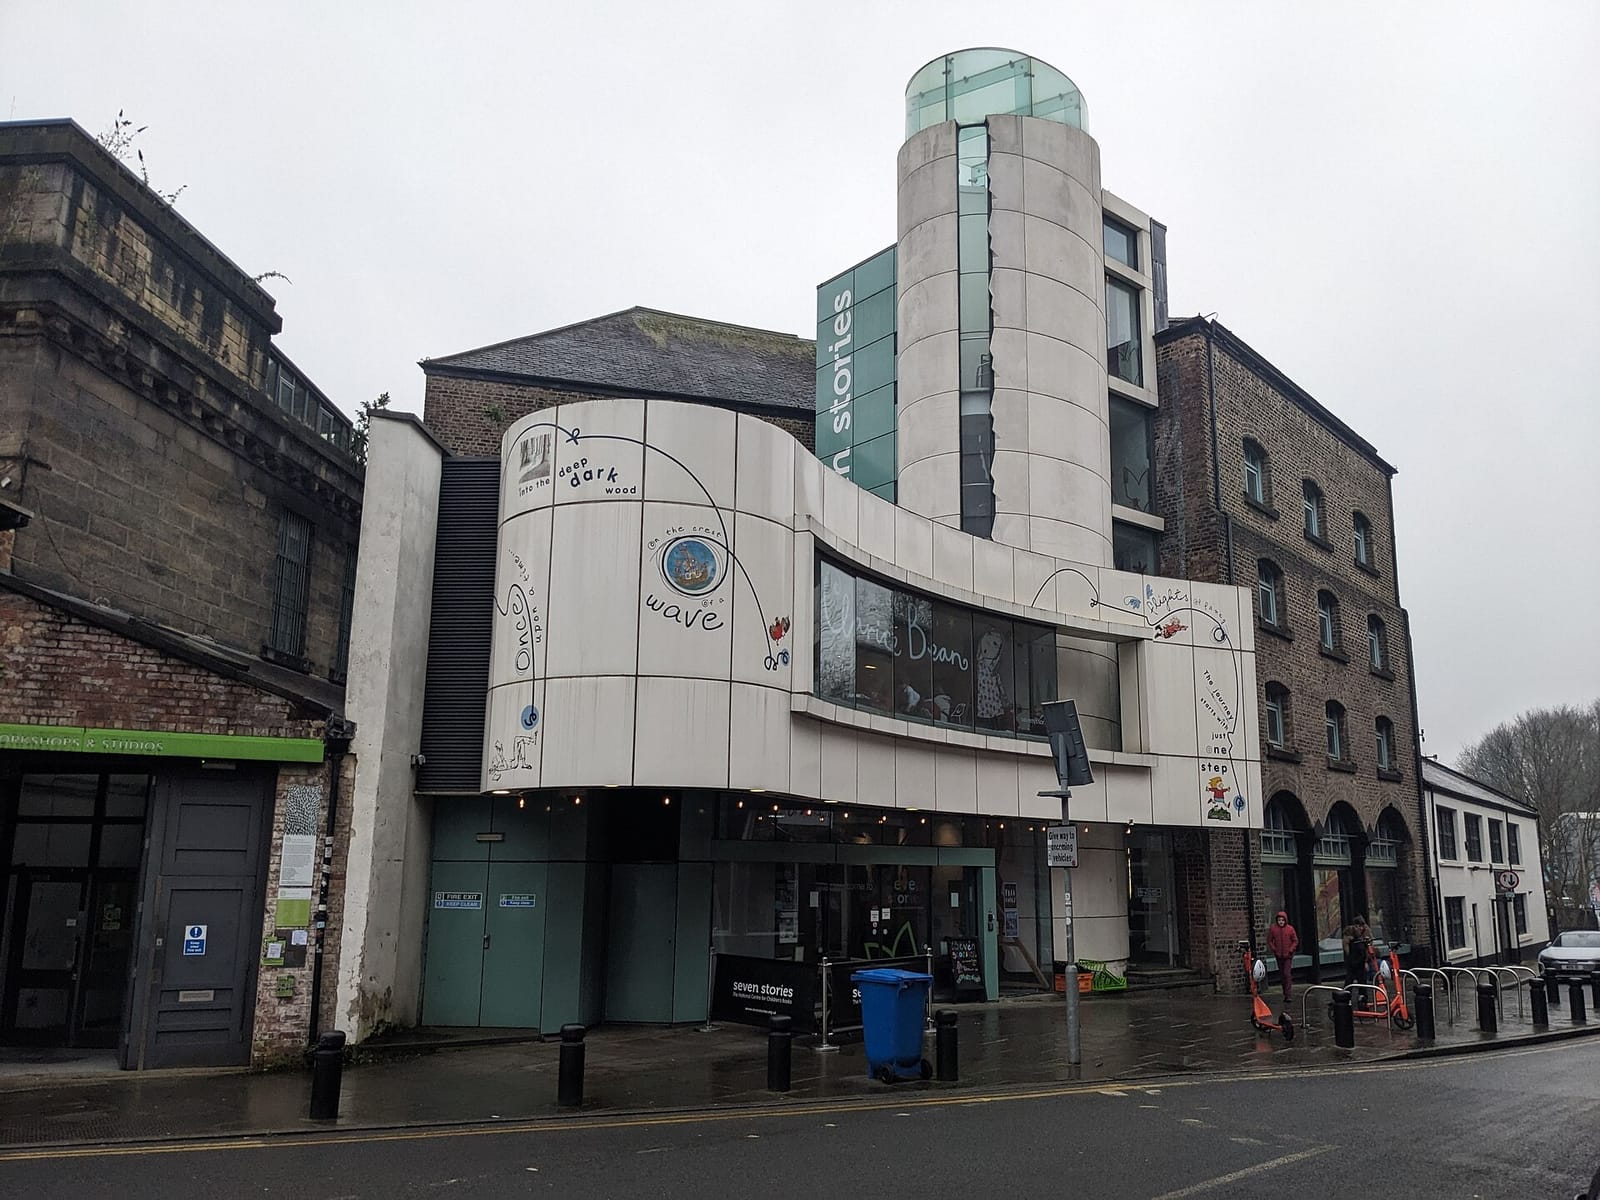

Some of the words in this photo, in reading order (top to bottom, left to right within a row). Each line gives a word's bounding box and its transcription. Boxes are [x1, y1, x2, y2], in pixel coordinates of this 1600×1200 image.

[828, 290, 852, 434] stories
[558, 457, 588, 478] deep
[536, 478, 550, 488] the
[570, 466, 618, 487] dark
[605, 485, 637, 494] wood
[666, 526, 685, 536] the
[692, 526, 722, 538] crest
[528, 586, 535, 596] a
[1146, 588, 1189, 616] flights
[646, 594, 724, 631] wave
[534, 606, 543, 644] upon
[907, 602, 969, 671] Bean
[1203, 669, 1214, 686] The
[1212, 688, 1234, 721] journey
[1200, 697, 1217, 717] starts
[1216, 716, 1230, 731] with
[0, 734, 80, 748] ORKSHOPS
[86, 738, 96, 749] &
[101, 739, 164, 752] STUDIOS
[1211, 731, 1227, 741] just
[1200, 762, 1228, 775] step
[1048, 831, 1059, 841] Give
[1059, 832, 1069, 842] way
[1069, 831, 1075, 840] to
[1052, 852, 1072, 862] vehicles
[733, 981, 759, 994] seven
[760, 984, 794, 998] stories
